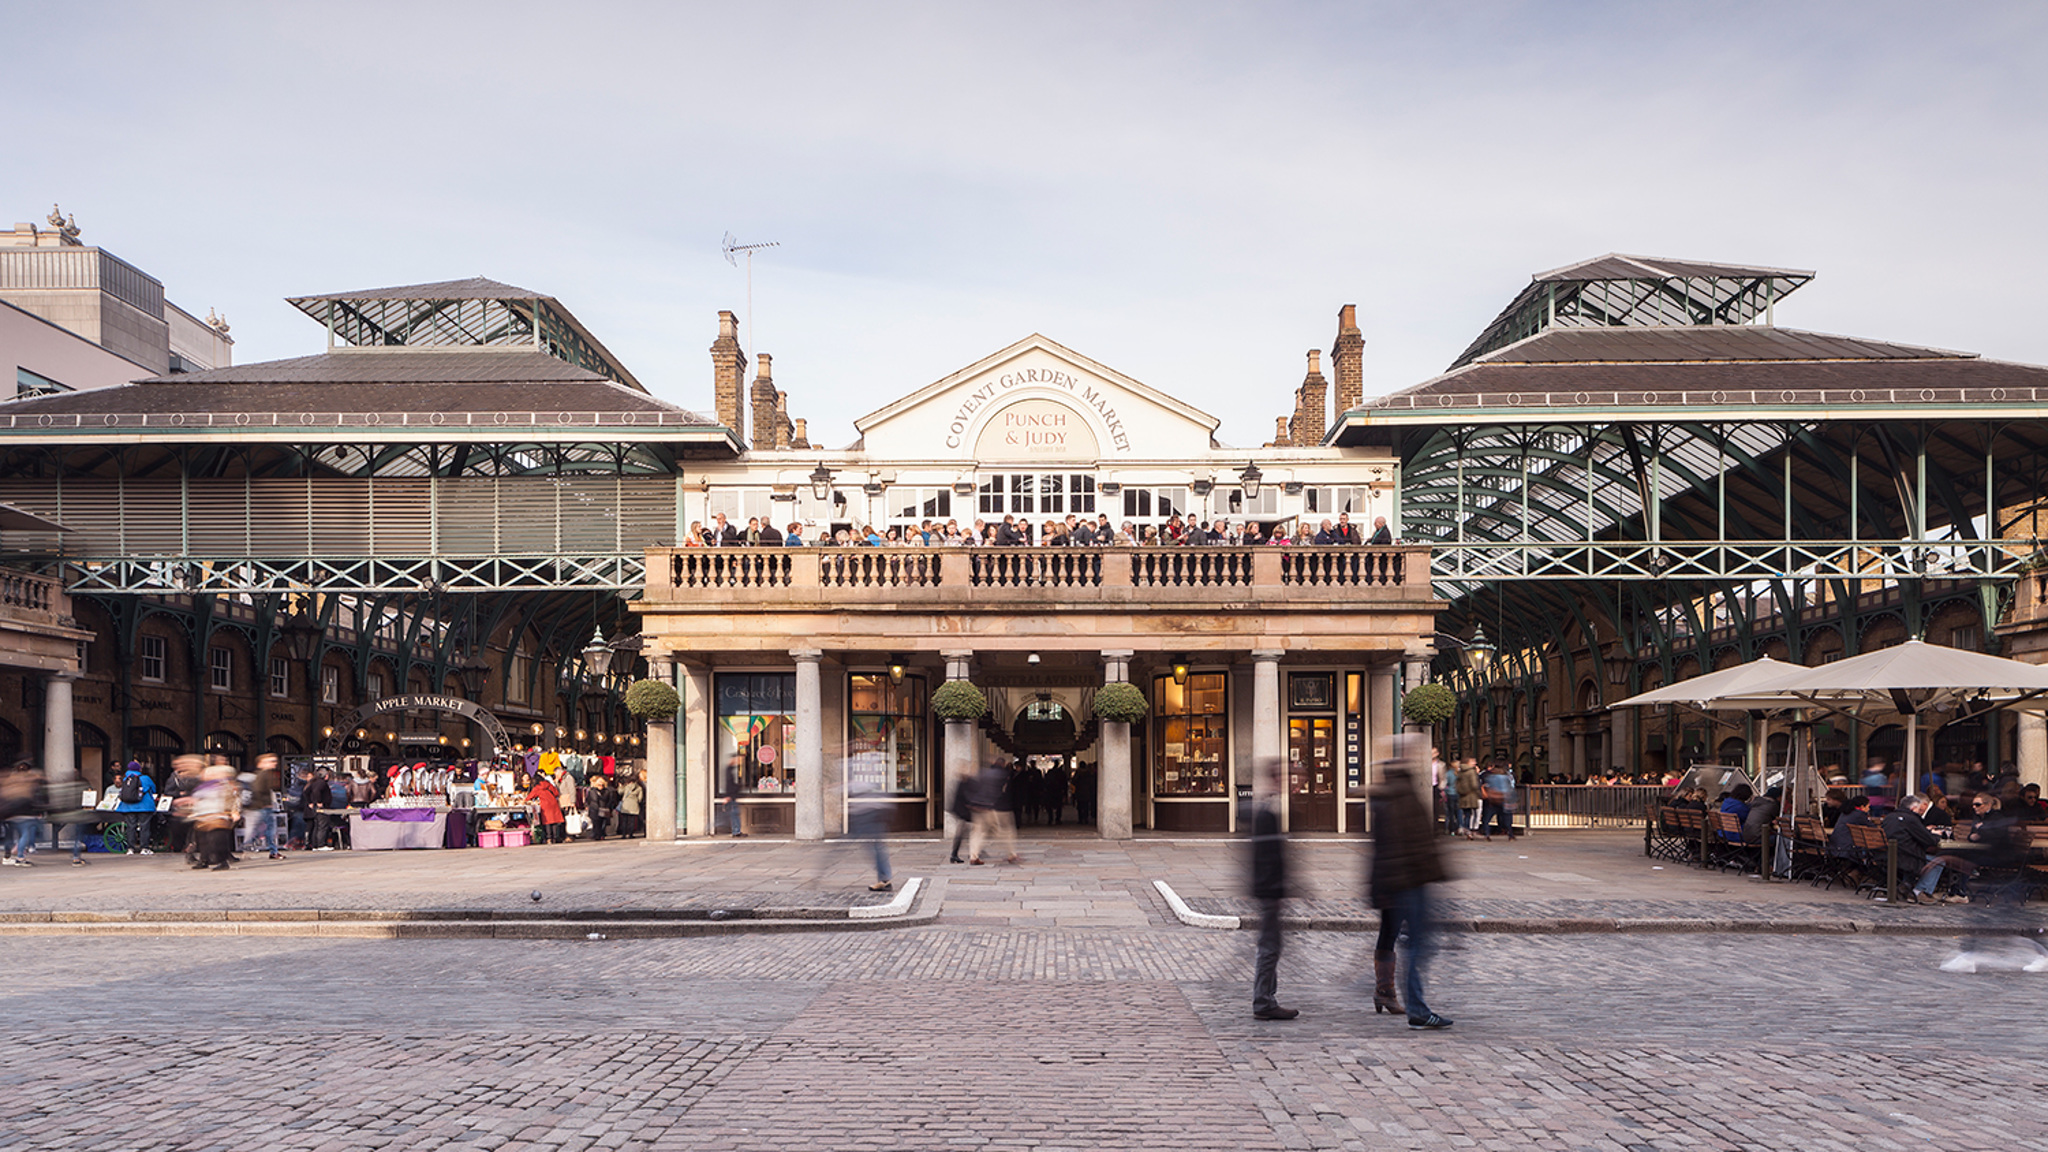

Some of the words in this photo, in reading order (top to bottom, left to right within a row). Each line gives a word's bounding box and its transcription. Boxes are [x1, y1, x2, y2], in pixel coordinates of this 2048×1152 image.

[945, 382, 996, 450] COVENT
[999, 368, 1078, 390] GARDEN
[1081, 386, 1131, 453] MARKET
[1005, 412, 1066, 427] PUNCH
[1005, 430, 1018, 445] &
[1025, 430, 1067, 447] JUDY
[1045, 674, 1096, 685] AVENUE
[140, 699, 173, 711] CHANEL
[374, 696, 409, 712] APPLE
[414, 695, 465, 711] MARKET
[271, 712, 295, 722] CHANEL
